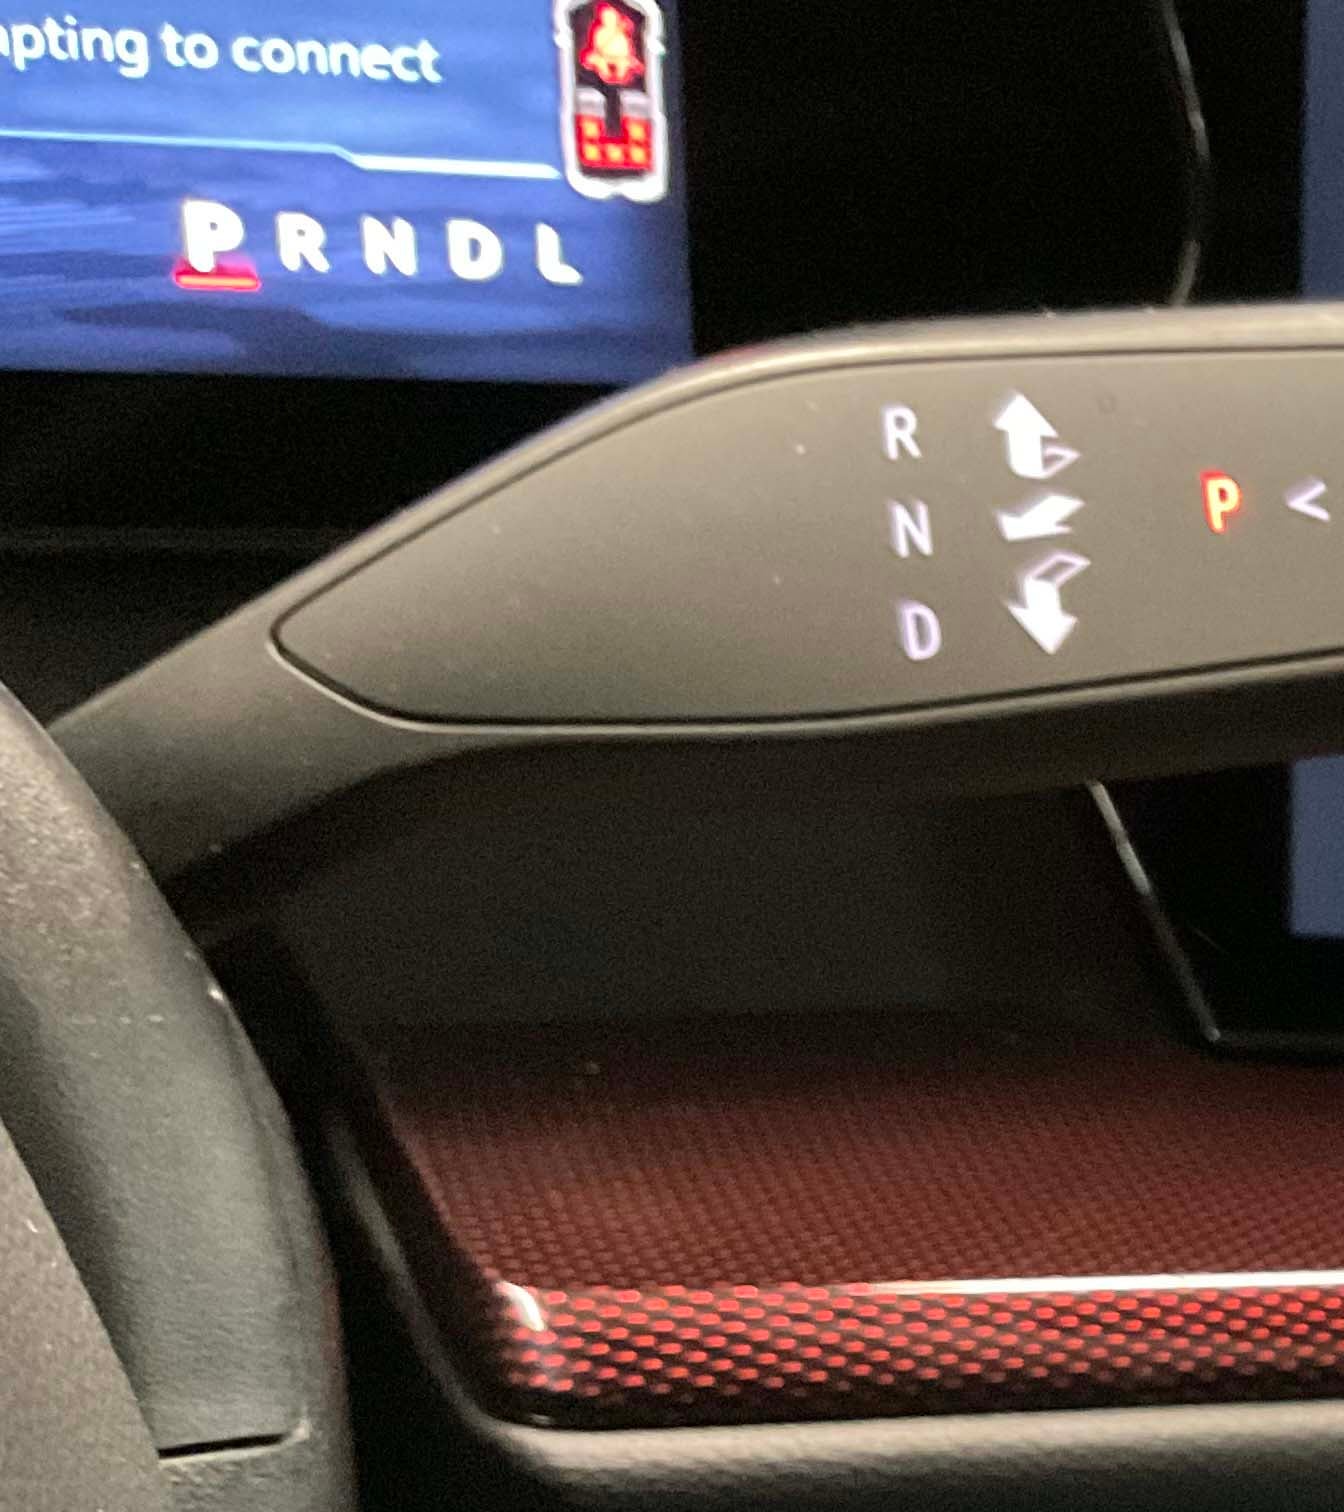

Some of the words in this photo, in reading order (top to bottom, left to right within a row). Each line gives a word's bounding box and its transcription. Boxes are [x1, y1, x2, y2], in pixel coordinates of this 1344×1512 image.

[160, 22, 219, 69] to
[232, 36, 442, 84] connect
[181, 199, 244, 273] P
[276, 211, 330, 274] R
[361, 215, 417, 276] N
[447, 218, 501, 281] D
[535, 223, 583, 285] L
[881, 405, 923, 461] R
[888, 498, 934, 559] N
[1200, 467, 1243, 534] P
[897, 599, 943, 662] D
